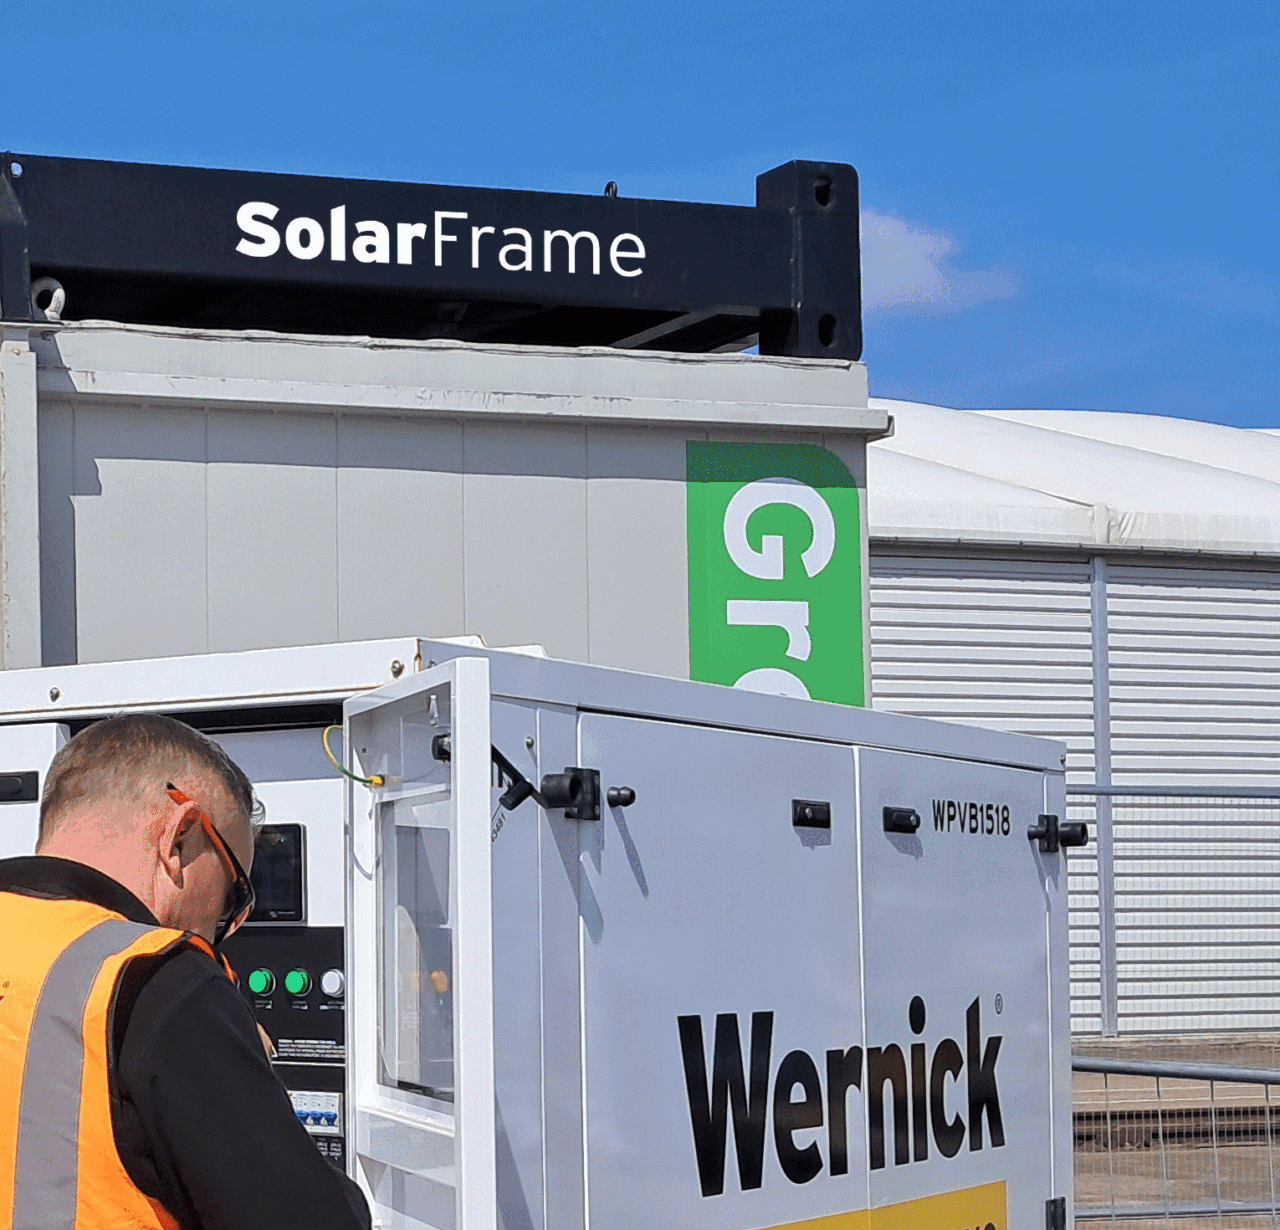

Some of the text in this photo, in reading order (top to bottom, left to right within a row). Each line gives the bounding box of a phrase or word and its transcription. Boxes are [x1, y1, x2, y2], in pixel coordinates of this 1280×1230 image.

[235, 201, 646, 277] SolarFrame
[931, 798, 1011, 836] WPVB1518
[676, 995, 1006, 1198] Wernick
